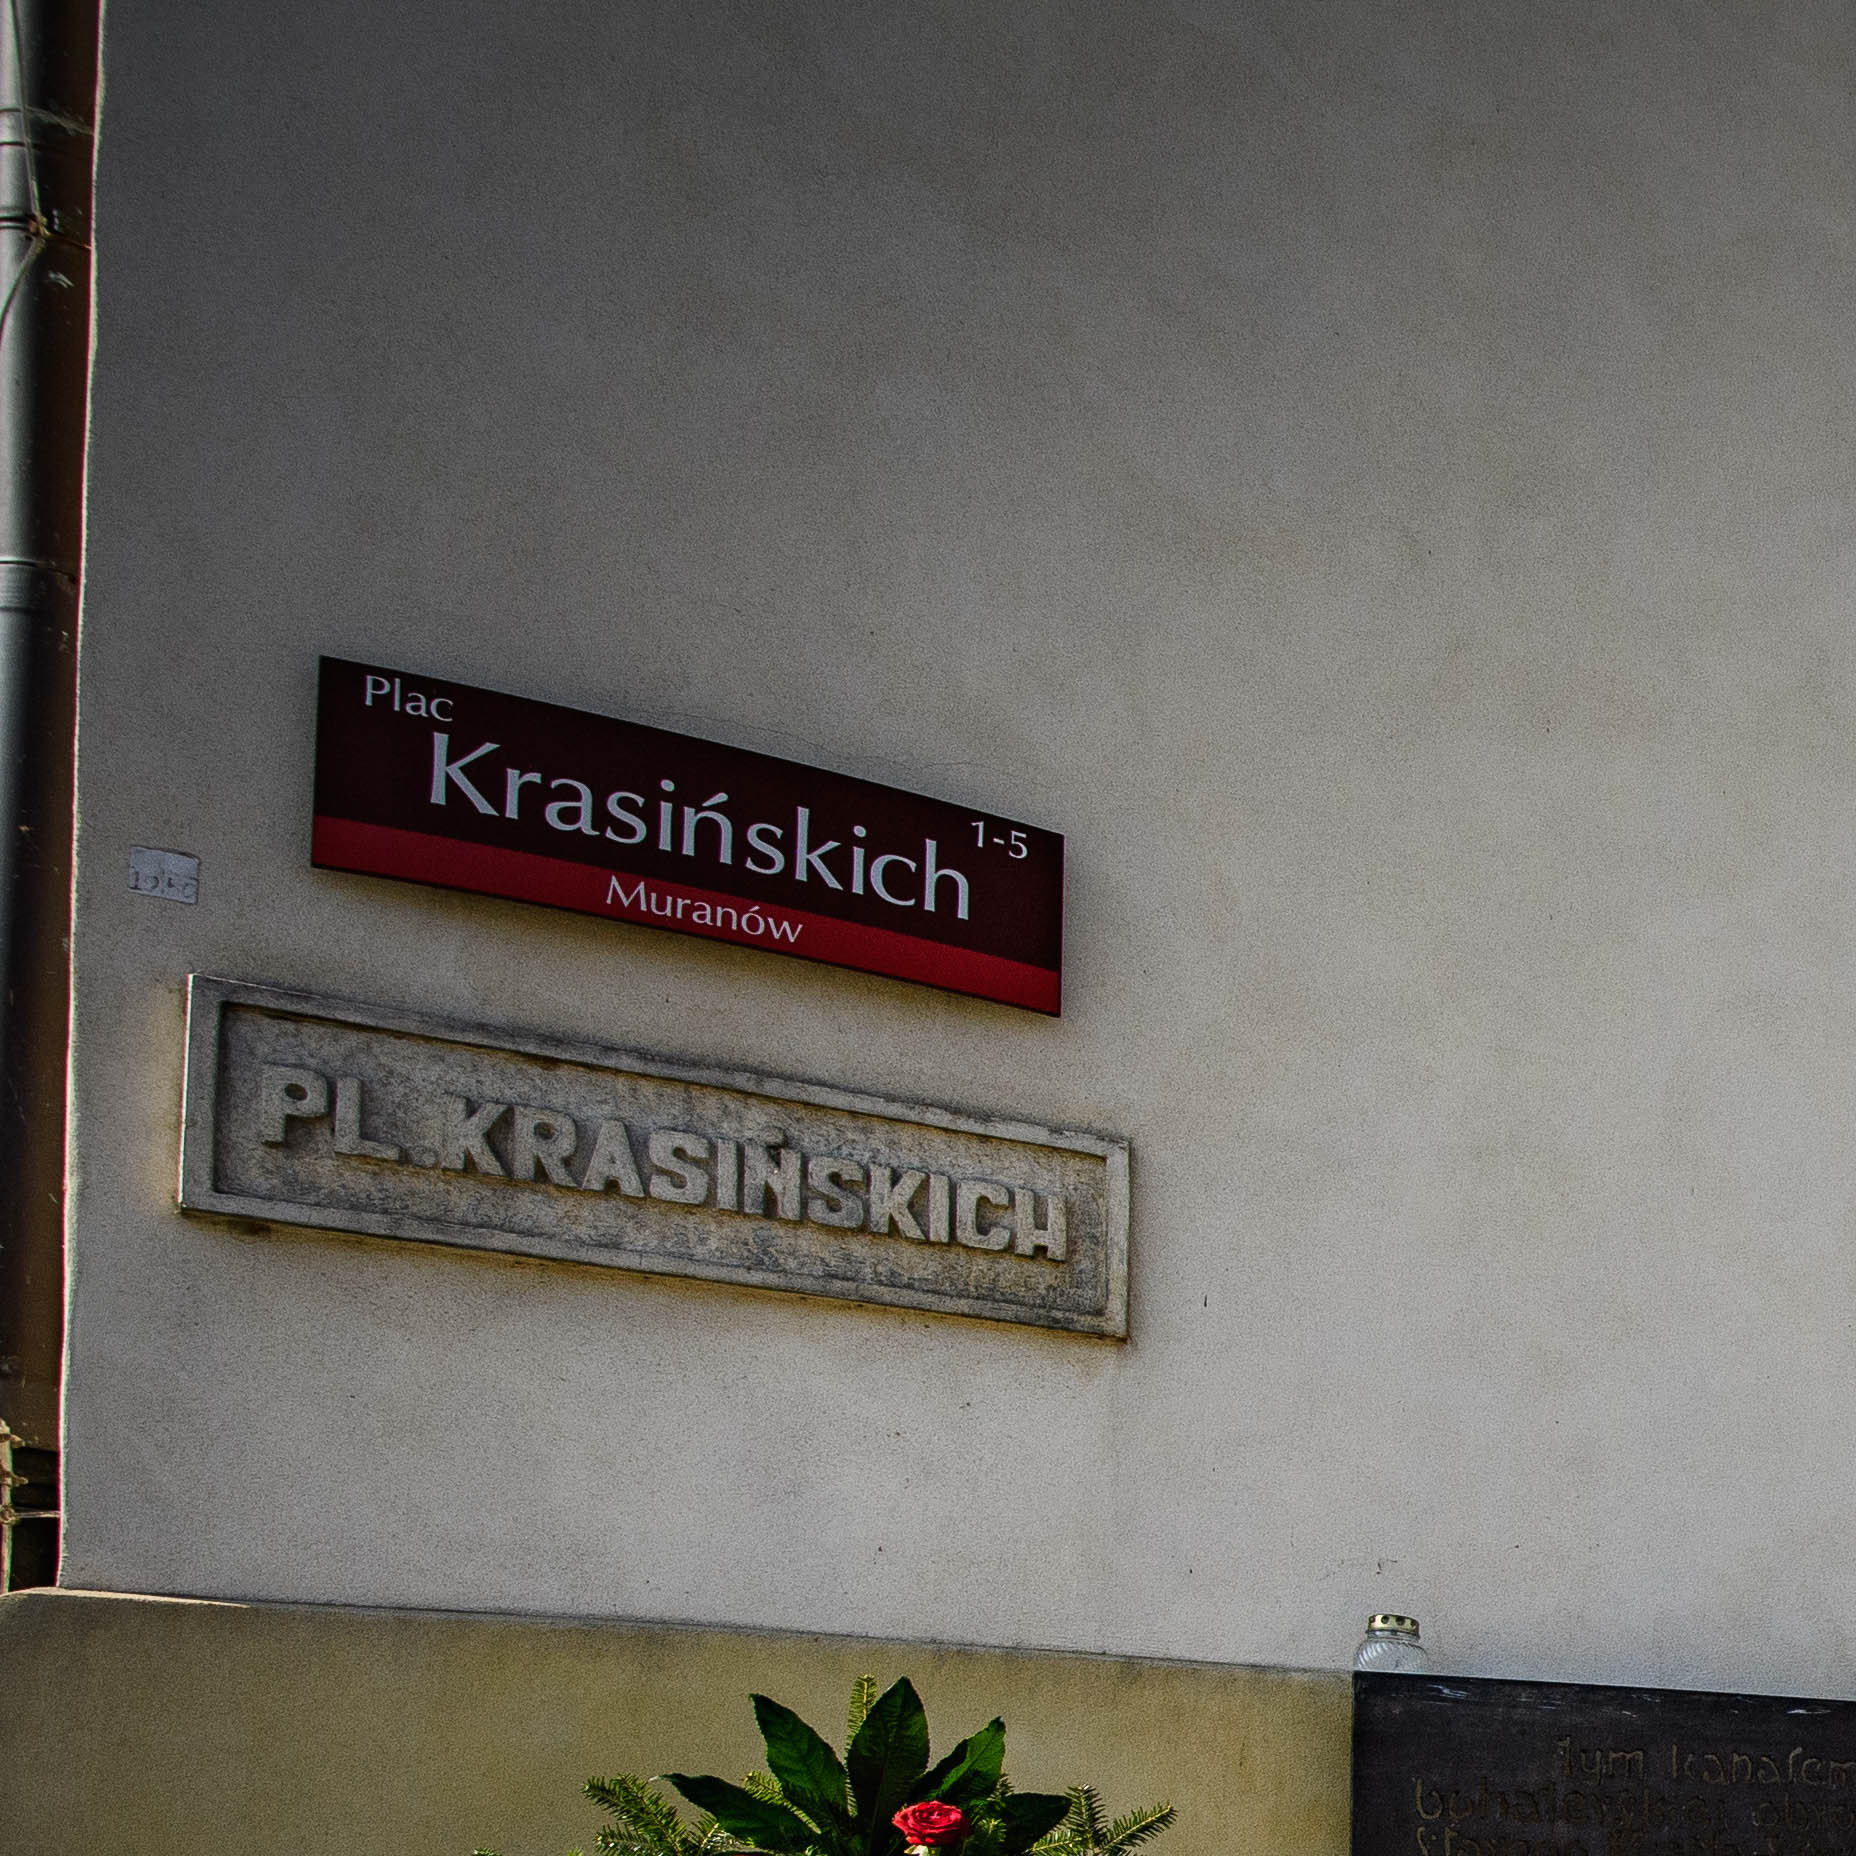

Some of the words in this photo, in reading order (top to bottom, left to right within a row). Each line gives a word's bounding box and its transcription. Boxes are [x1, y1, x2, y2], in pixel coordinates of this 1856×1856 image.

[363, 674, 454, 723] Plac
[427, 732, 972, 922] Krasińskich
[967, 818, 1029, 862] 1-5
[604, 875, 804, 945] Muranów
